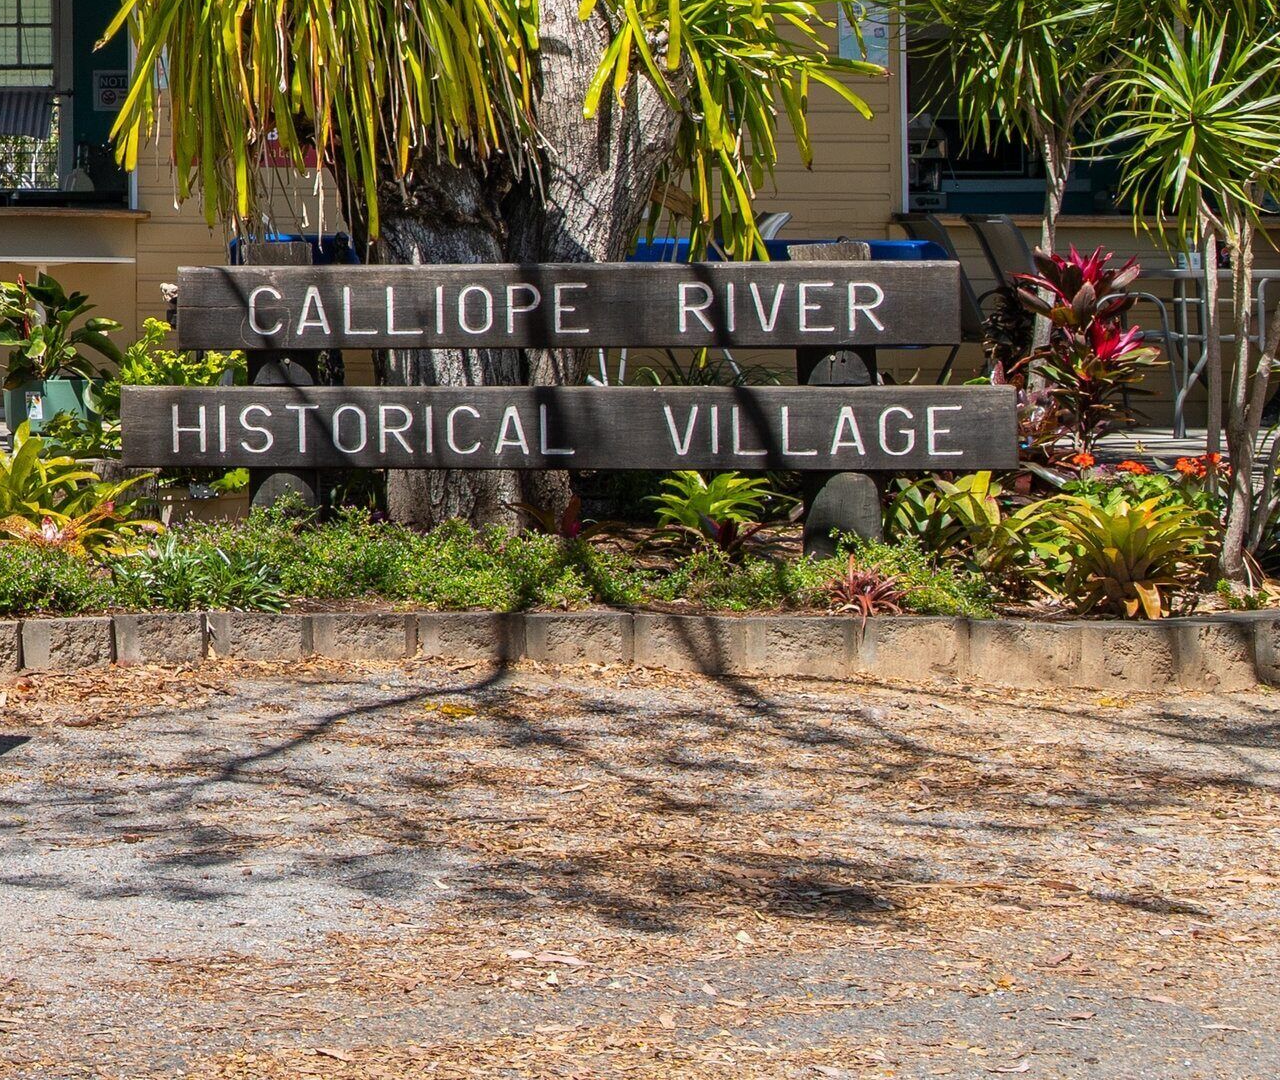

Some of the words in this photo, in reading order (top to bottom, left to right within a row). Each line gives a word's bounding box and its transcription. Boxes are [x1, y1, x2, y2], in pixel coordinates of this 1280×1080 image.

[100, 77, 128, 88] NOTI
[247, 282, 591, 338] CALLIOPE
[676, 280, 886, 333] RIVER
[171, 402, 577, 456] HISTORICAL
[665, 404, 965, 457] VILLAGE
